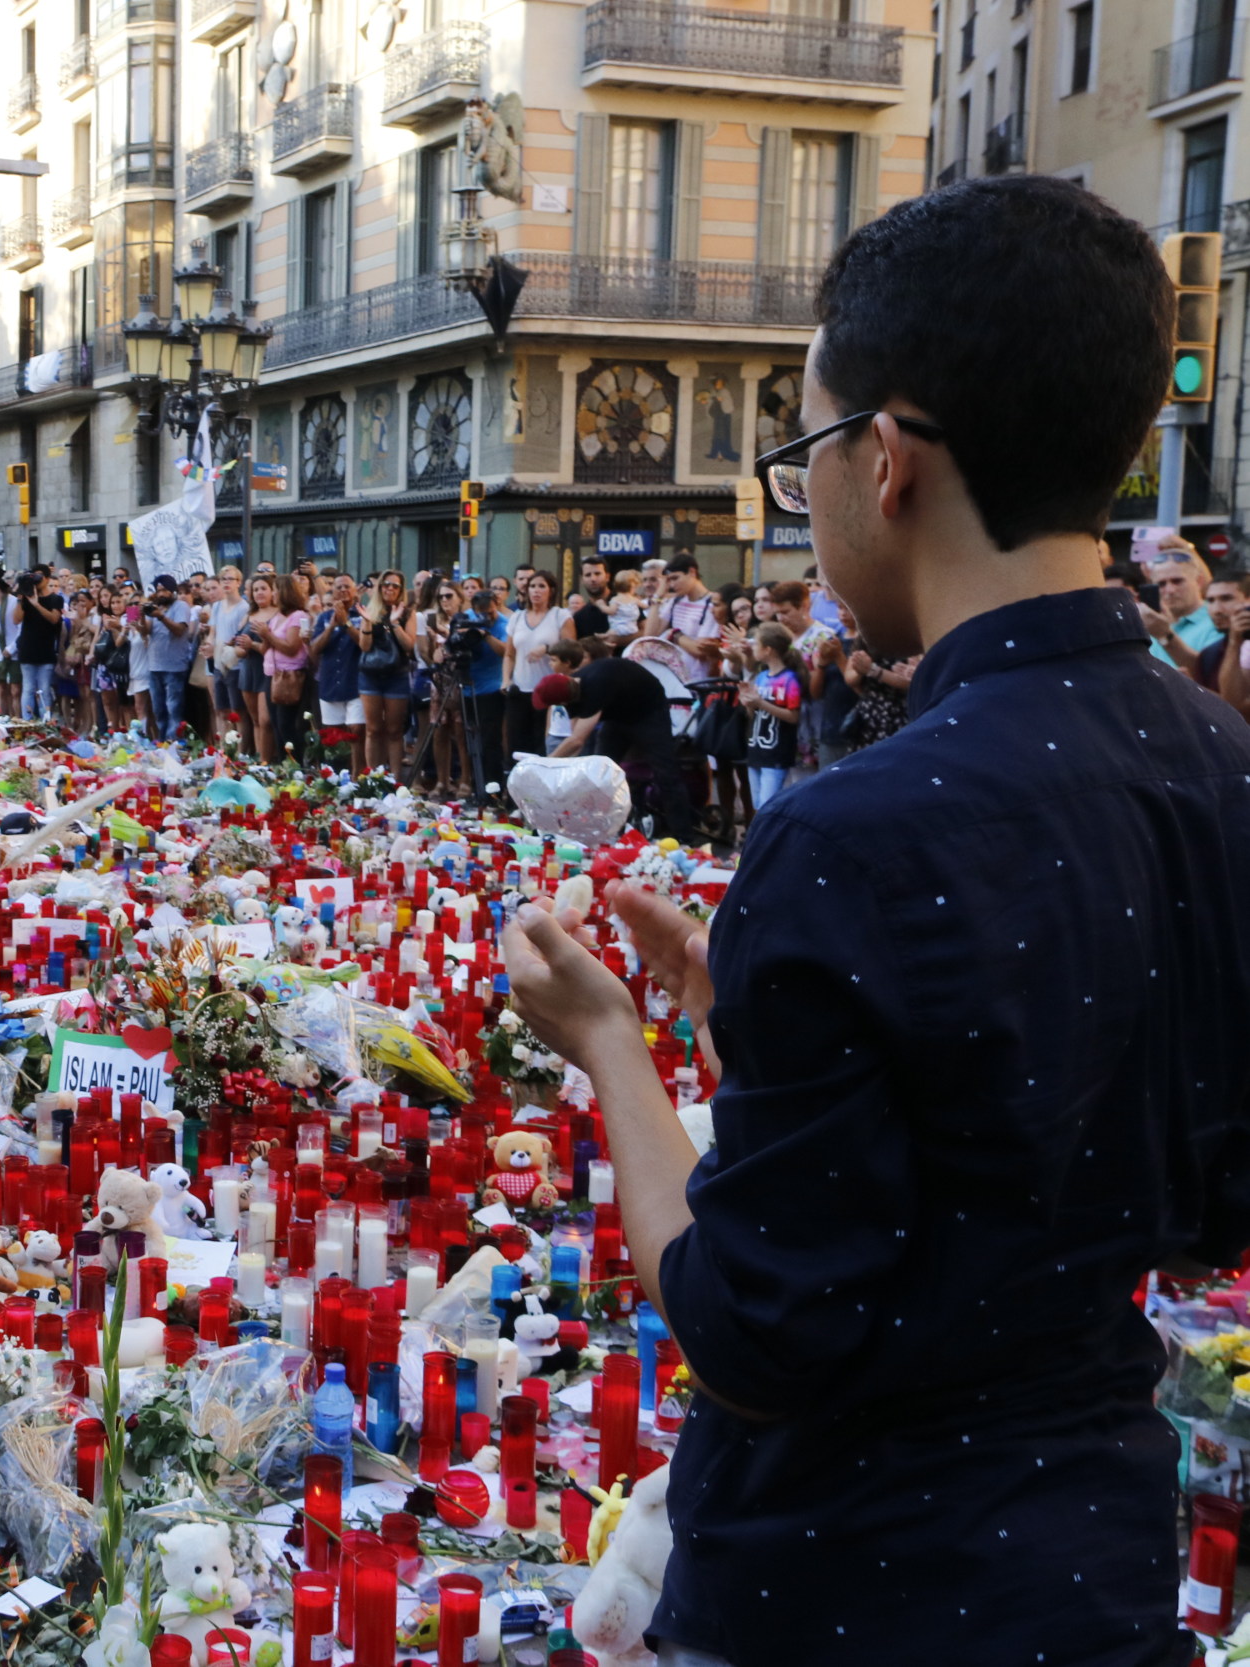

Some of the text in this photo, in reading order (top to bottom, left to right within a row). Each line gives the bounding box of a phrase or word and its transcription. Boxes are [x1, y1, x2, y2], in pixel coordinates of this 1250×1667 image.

[599, 533, 645, 552] BBVA
[64, 1055, 161, 1104] ISLAM = PAU
